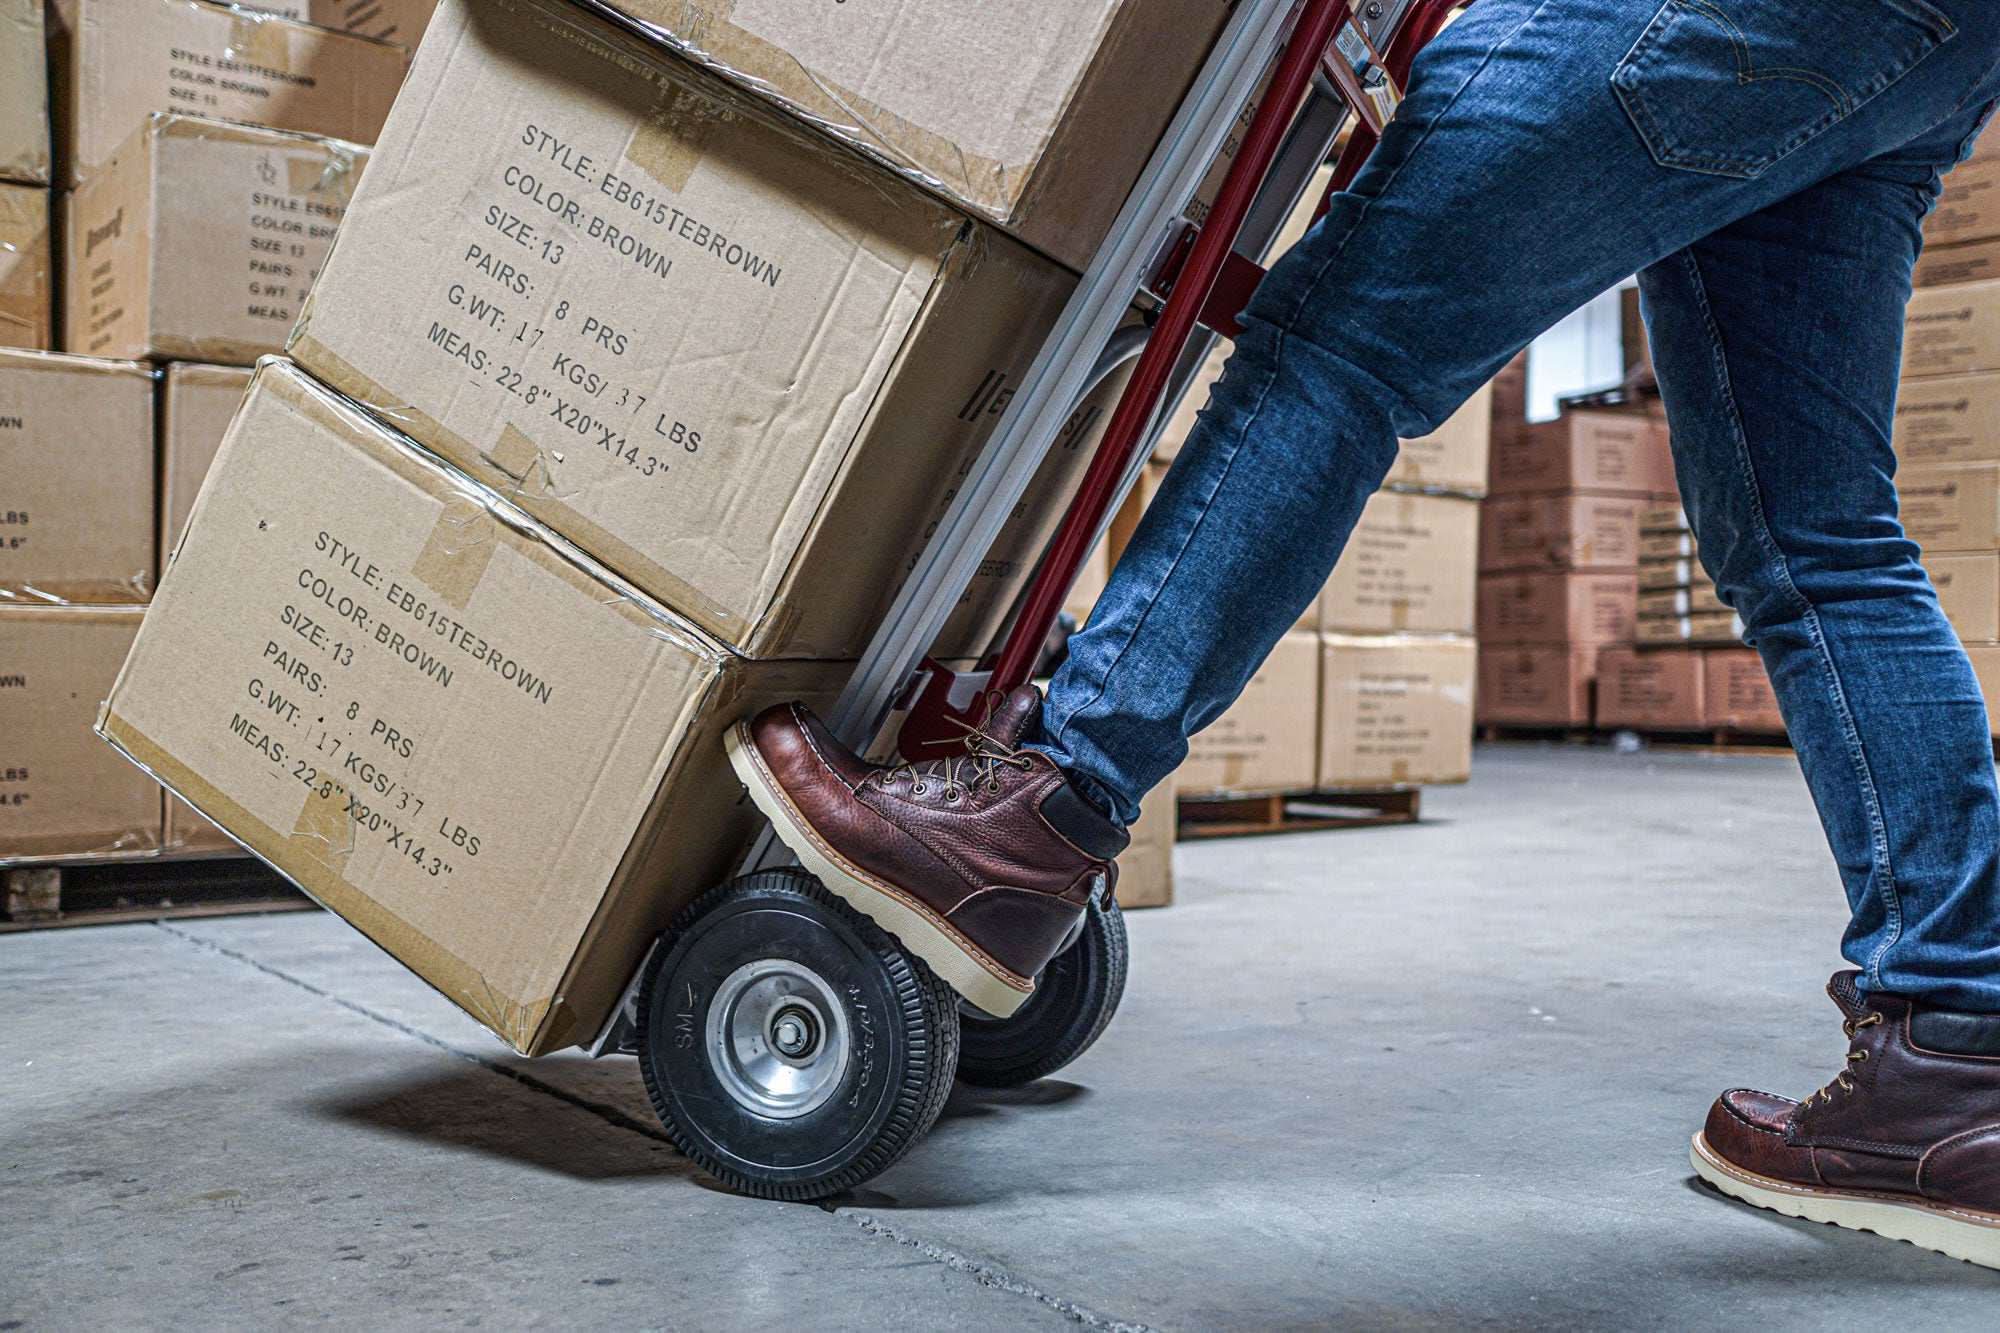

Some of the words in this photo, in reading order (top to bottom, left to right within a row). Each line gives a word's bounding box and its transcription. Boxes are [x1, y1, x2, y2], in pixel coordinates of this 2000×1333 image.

[484, 204, 538, 250] SIZE:
[540, 238, 565, 266] 13
[503, 165, 585, 227] COLOR:
[587, 215, 673, 279] BROWN
[521, 124, 597, 183] STYLE:
[600, 173, 783, 288] EB615TEBROWN
[426, 321, 493, 376] MEAS:
[464, 243, 535, 300] PAIRS:
[555, 300, 570, 321] 8
[581, 316, 629, 357] PRS
[447, 283, 506, 333] G.WT:
[655, 413, 702, 454] LBS
[280, 604, 329, 651] SIZE:
[333, 641, 355, 668] 13
[298, 568, 373, 634] COLOR:
[374, 623, 454, 688] BROWN
[314, 530, 384, 591] STYLE:
[386, 583, 553, 705] EB615TEBROWN
[229, 712, 289, 769] MEAS:
[263, 640, 327, 698] PAIRS:
[346, 701, 360, 721] 8
[369, 718, 414, 759] PRS
[247, 678, 301, 728] G.WT:
[439, 816, 481, 857] LBS
